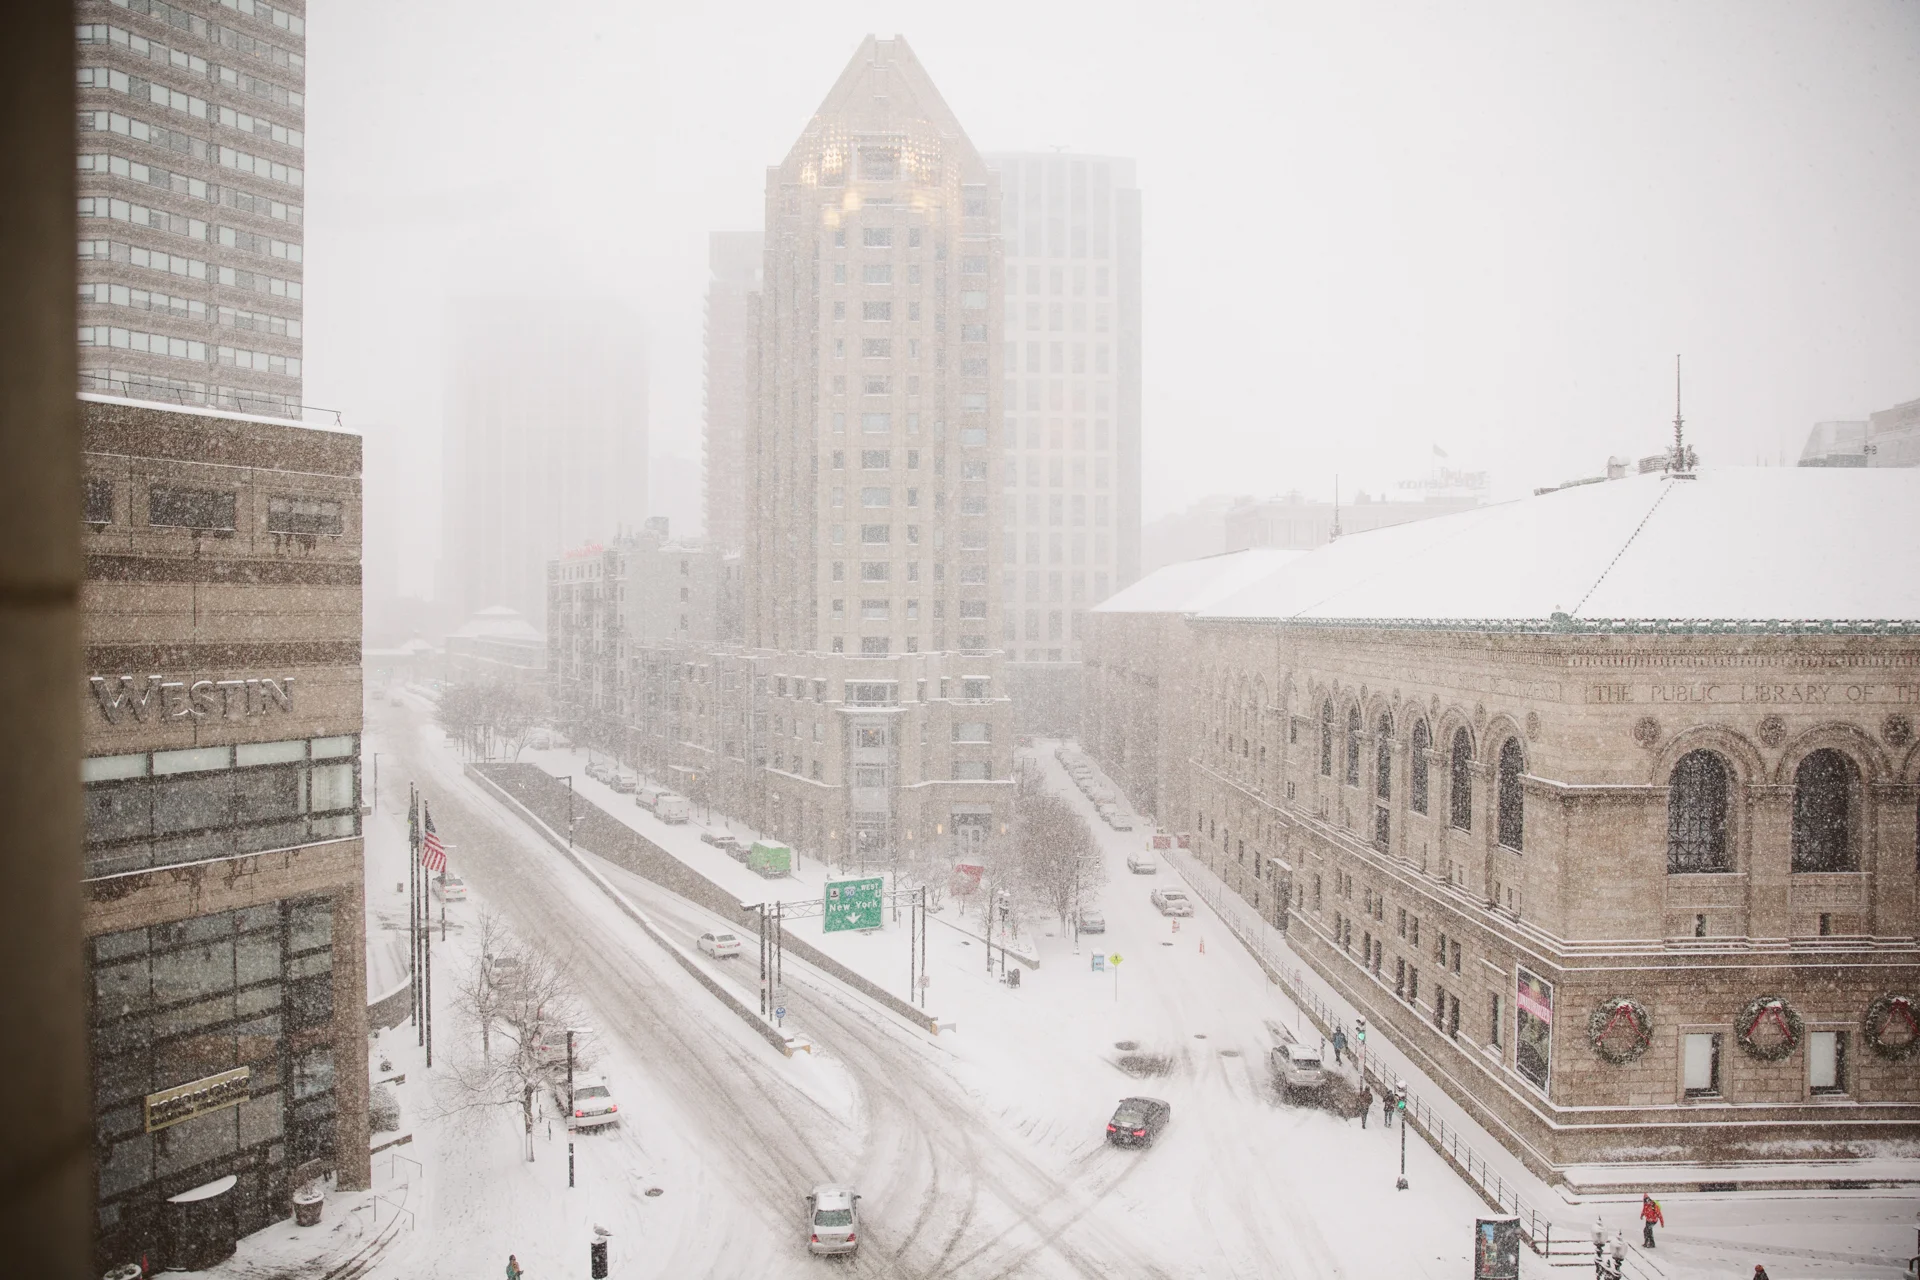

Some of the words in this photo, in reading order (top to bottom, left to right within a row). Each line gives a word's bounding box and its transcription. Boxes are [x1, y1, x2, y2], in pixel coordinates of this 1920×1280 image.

[89, 675, 295, 724] WESTIN
[1593, 685, 1635, 702] THE
[1651, 685, 1721, 702] PUBLIC
[1741, 685, 1831, 702] LIBRARY
[1846, 685, 1875, 701] OF
[855, 900, 877, 909] York
